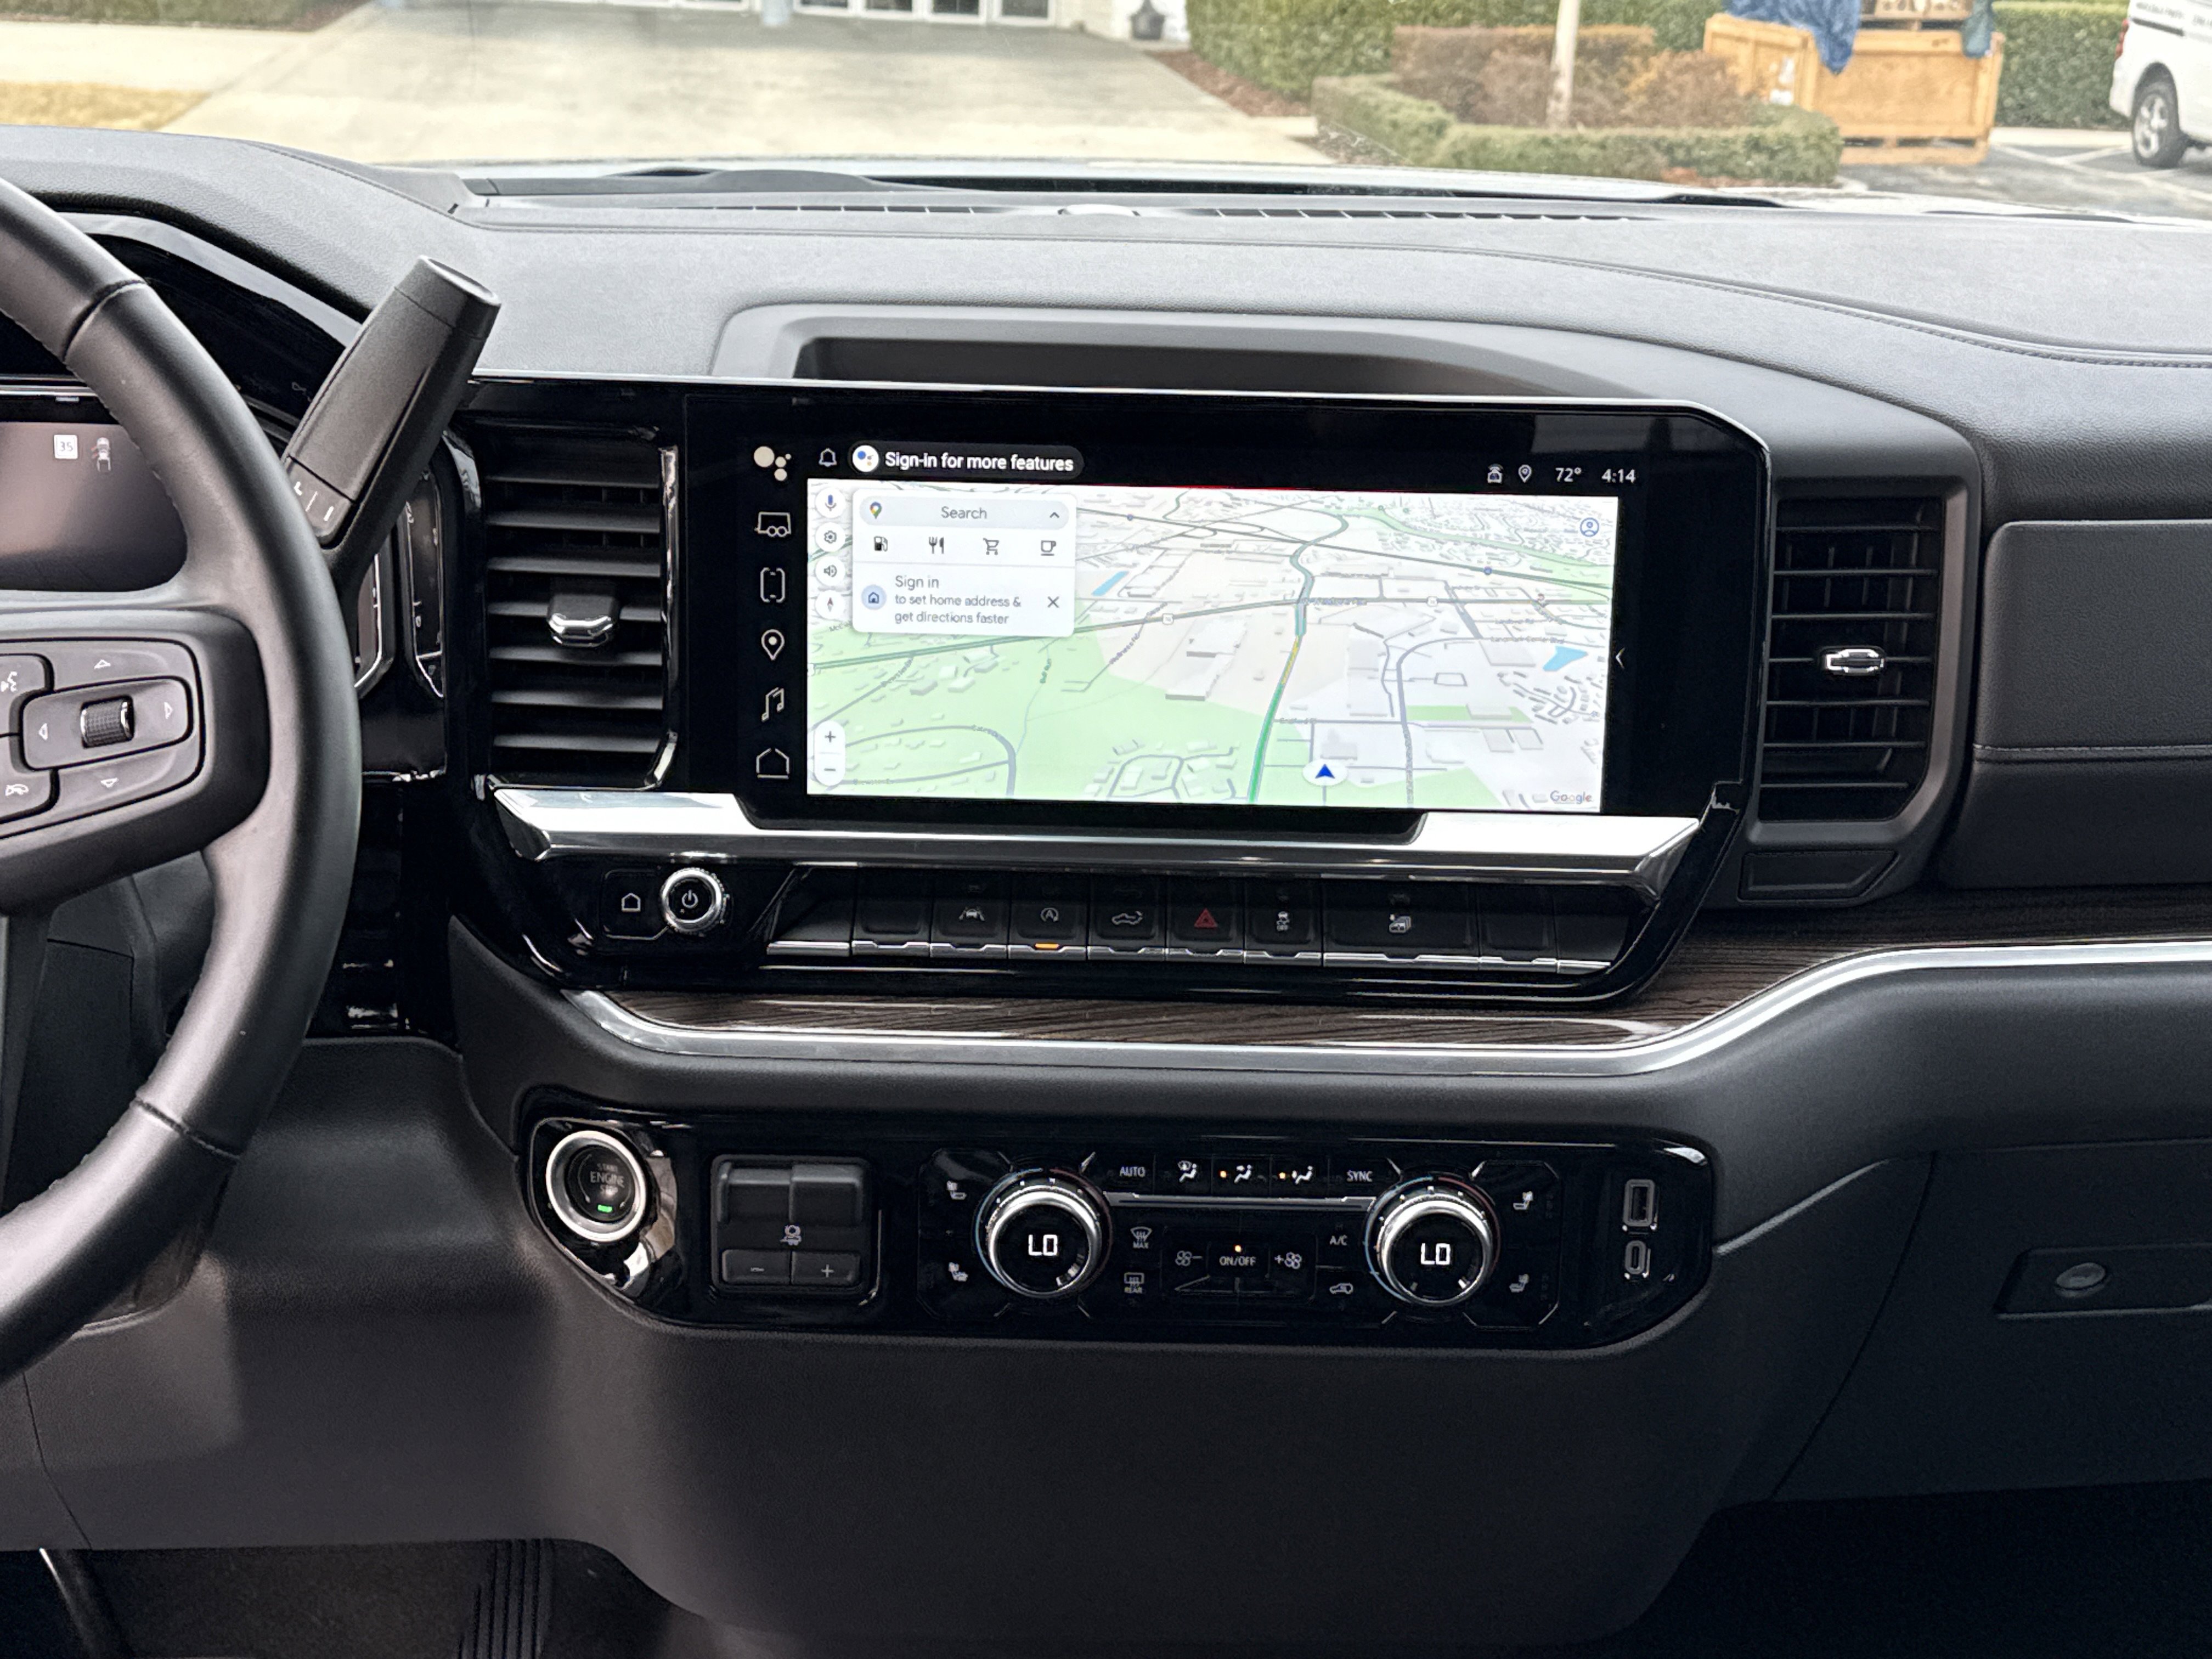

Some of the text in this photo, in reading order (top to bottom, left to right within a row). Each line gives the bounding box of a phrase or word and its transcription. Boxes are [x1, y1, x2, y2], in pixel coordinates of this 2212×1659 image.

[59, 441, 74, 452] 35
[885, 452, 1074, 472] Sign-in for more features
[1601, 469, 1637, 483] 4:14
[941, 505, 988, 519] Search
[895, 575, 939, 591] Sign in
[895, 594, 1022, 607] to set home address &
[895, 611, 1009, 624] get directions faster
[1550, 790, 1593, 805] Google
[1119, 1166, 1146, 1178] AUTO
[1346, 1170, 1373, 1182] SYNC
[590, 1171, 625, 1188] ENGINE
[1028, 1234, 1058, 1256] LO
[1329, 1235, 1348, 1246] A/C
[1420, 1243, 1451, 1265] LO
[1219, 1256, 1256, 1267] ON/OFF
[1124, 1286, 1143, 1294] REAR
